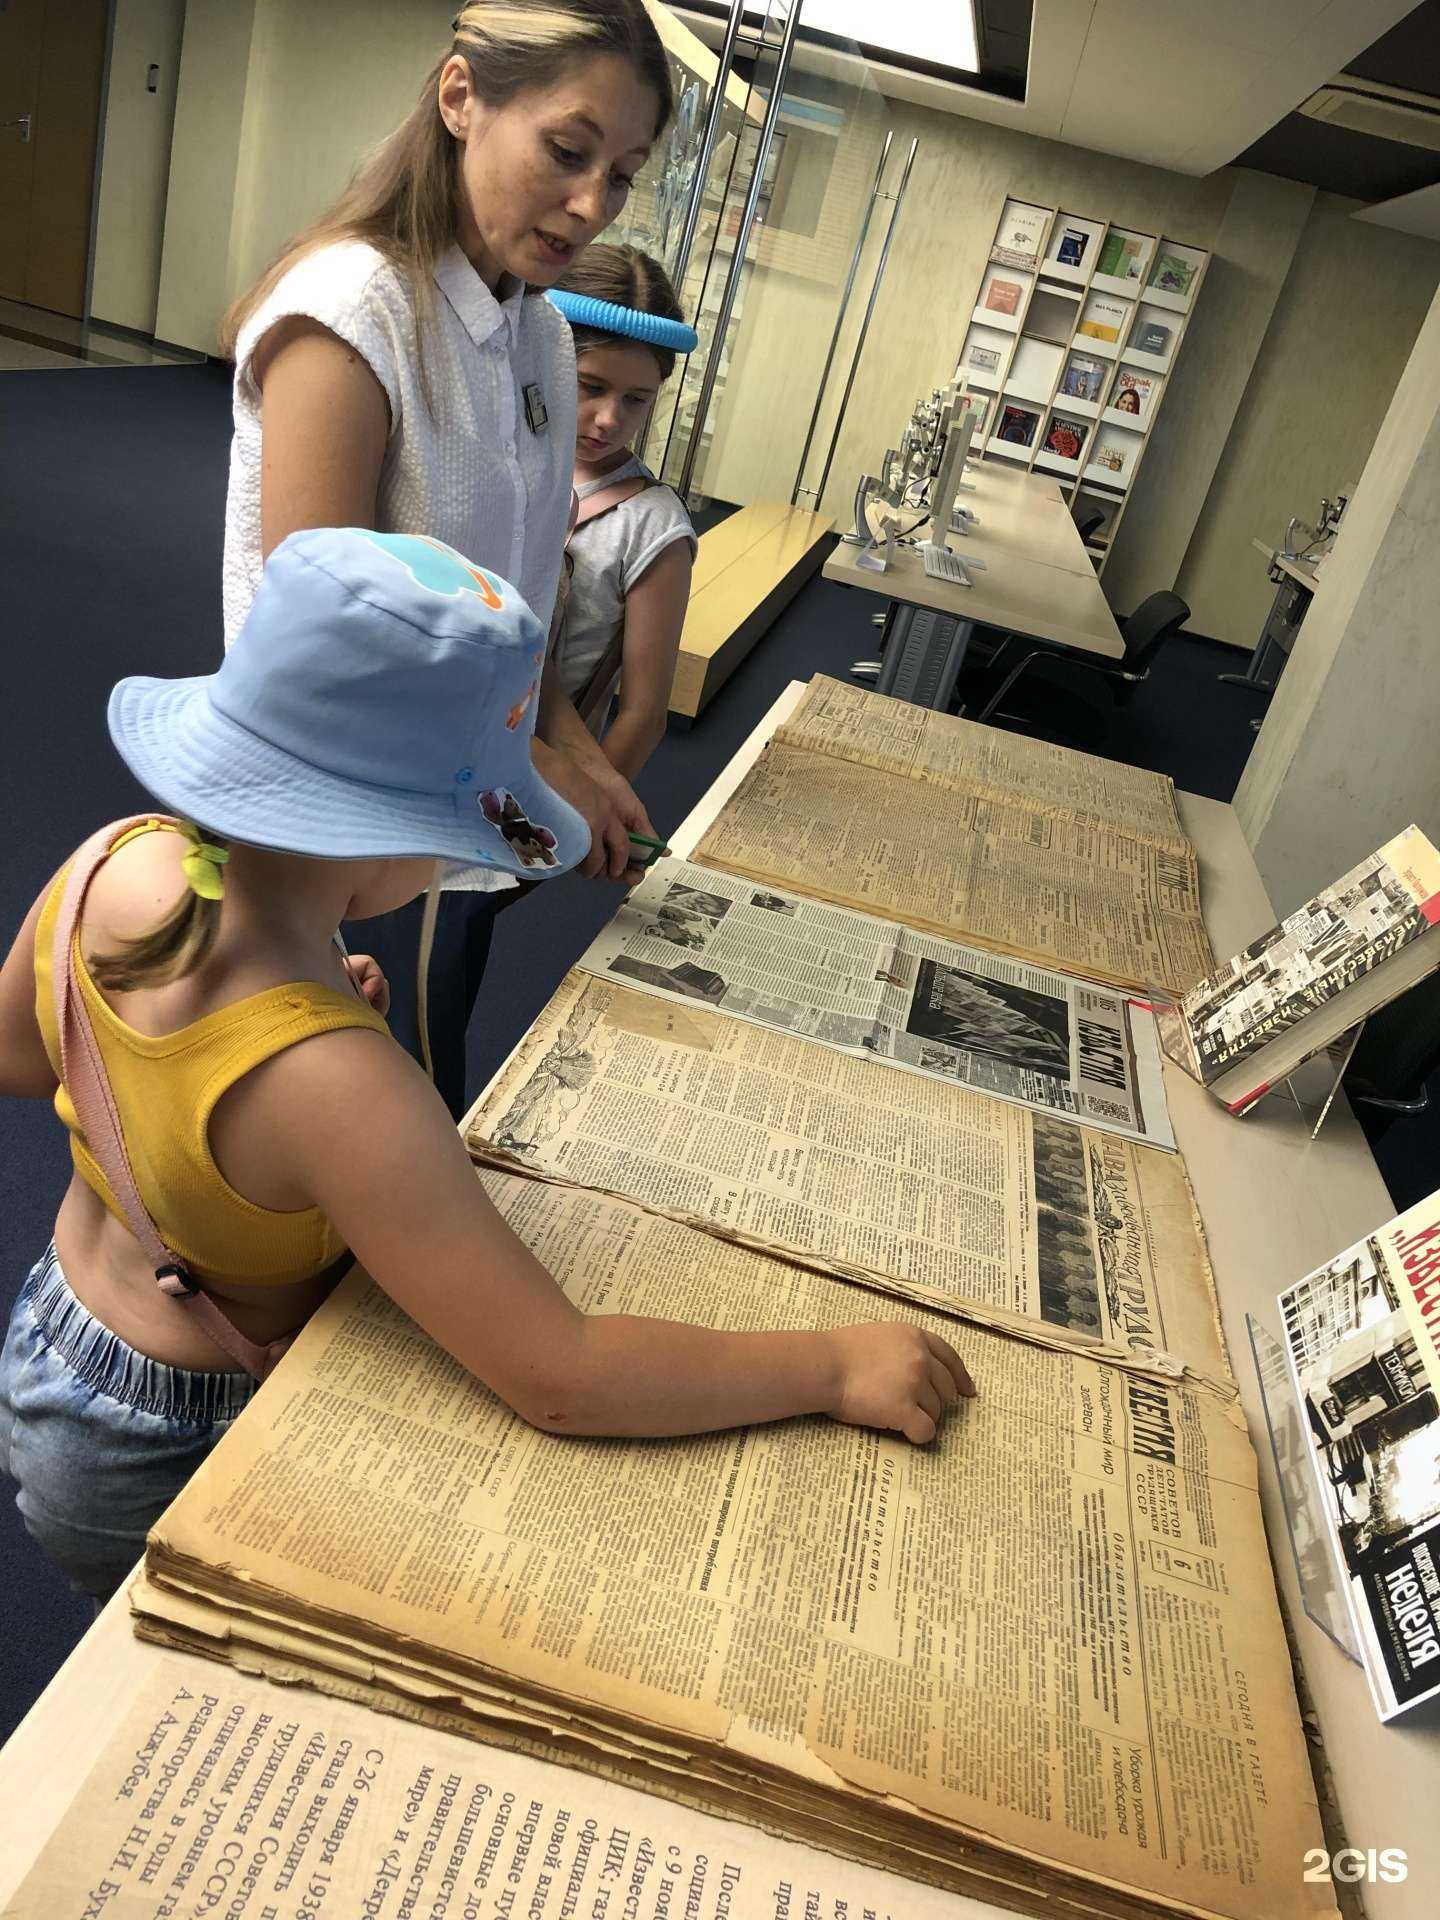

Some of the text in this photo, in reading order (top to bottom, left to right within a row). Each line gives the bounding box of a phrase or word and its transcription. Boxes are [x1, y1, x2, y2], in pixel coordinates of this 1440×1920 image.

[1121, 372, 1151, 387] Speak
[1302, 915, 1417, 1002] НЕИЗВЕСТНЫЕ
[725, 1470, 738, 1498] товаров
[1102, 1448, 1113, 1474] мир
[1137, 1474, 1147, 1514] СССР
[715, 1499, 730, 1536] широкого
[868, 1459, 894, 1591] Обязательство
[1147, 1464, 1159, 1531] ТРУДЯЩИХСЯ
[1156, 1466, 1169, 1535] ДЕПУТАТОВ
[1166, 1469, 1181, 1538] СОВЕТОВ
[700, 1539, 719, 1591] потребления
[1174, 1560, 1191, 1570] 6
[1411, 1541, 1439, 1599] ВОСКРЕСНОЕ
[1114, 1533, 1131, 1675] Обязательство
[115, 1687, 193, 1800] А. Аджубея.
[321, 1740, 352, 1788] стала
[1235, 1671, 1254, 1730] СЕГОДНЯ
[1250, 1754, 1267, 1808] ГАЗЕТЕ:
[80, 1694, 219, 1920] редакторства Н.И. Бух
[139, 1706, 244, 1884] отличалась в годы
[233, 1723, 300, 1835] трудящихся
[403, 1766, 434, 1823] мире»
[1113, 1747, 1128, 1835] и хлебосдача
[1129, 1748, 1147, 1848] Уборка урожая
[153, 1713, 272, 1920] высоким уровнем га
[225, 1732, 326, 1920] «Известия Советов
[274, 1794, 328, 1891] выходить
[296, 1749, 383, 1920] С 26 января 1938
[394, 1829, 409, 1843] и
[397, 1774, 461, 1920] правительства
[474, 1793, 515, 1888] основные
[508, 1800, 543, 1883] впервые
[543, 1809, 570, 1868] новой
[668, 1846, 680, 1855] с
[599, 1828, 630, 1881] ЦИК;
[666, 1861, 682, 1874] 9
